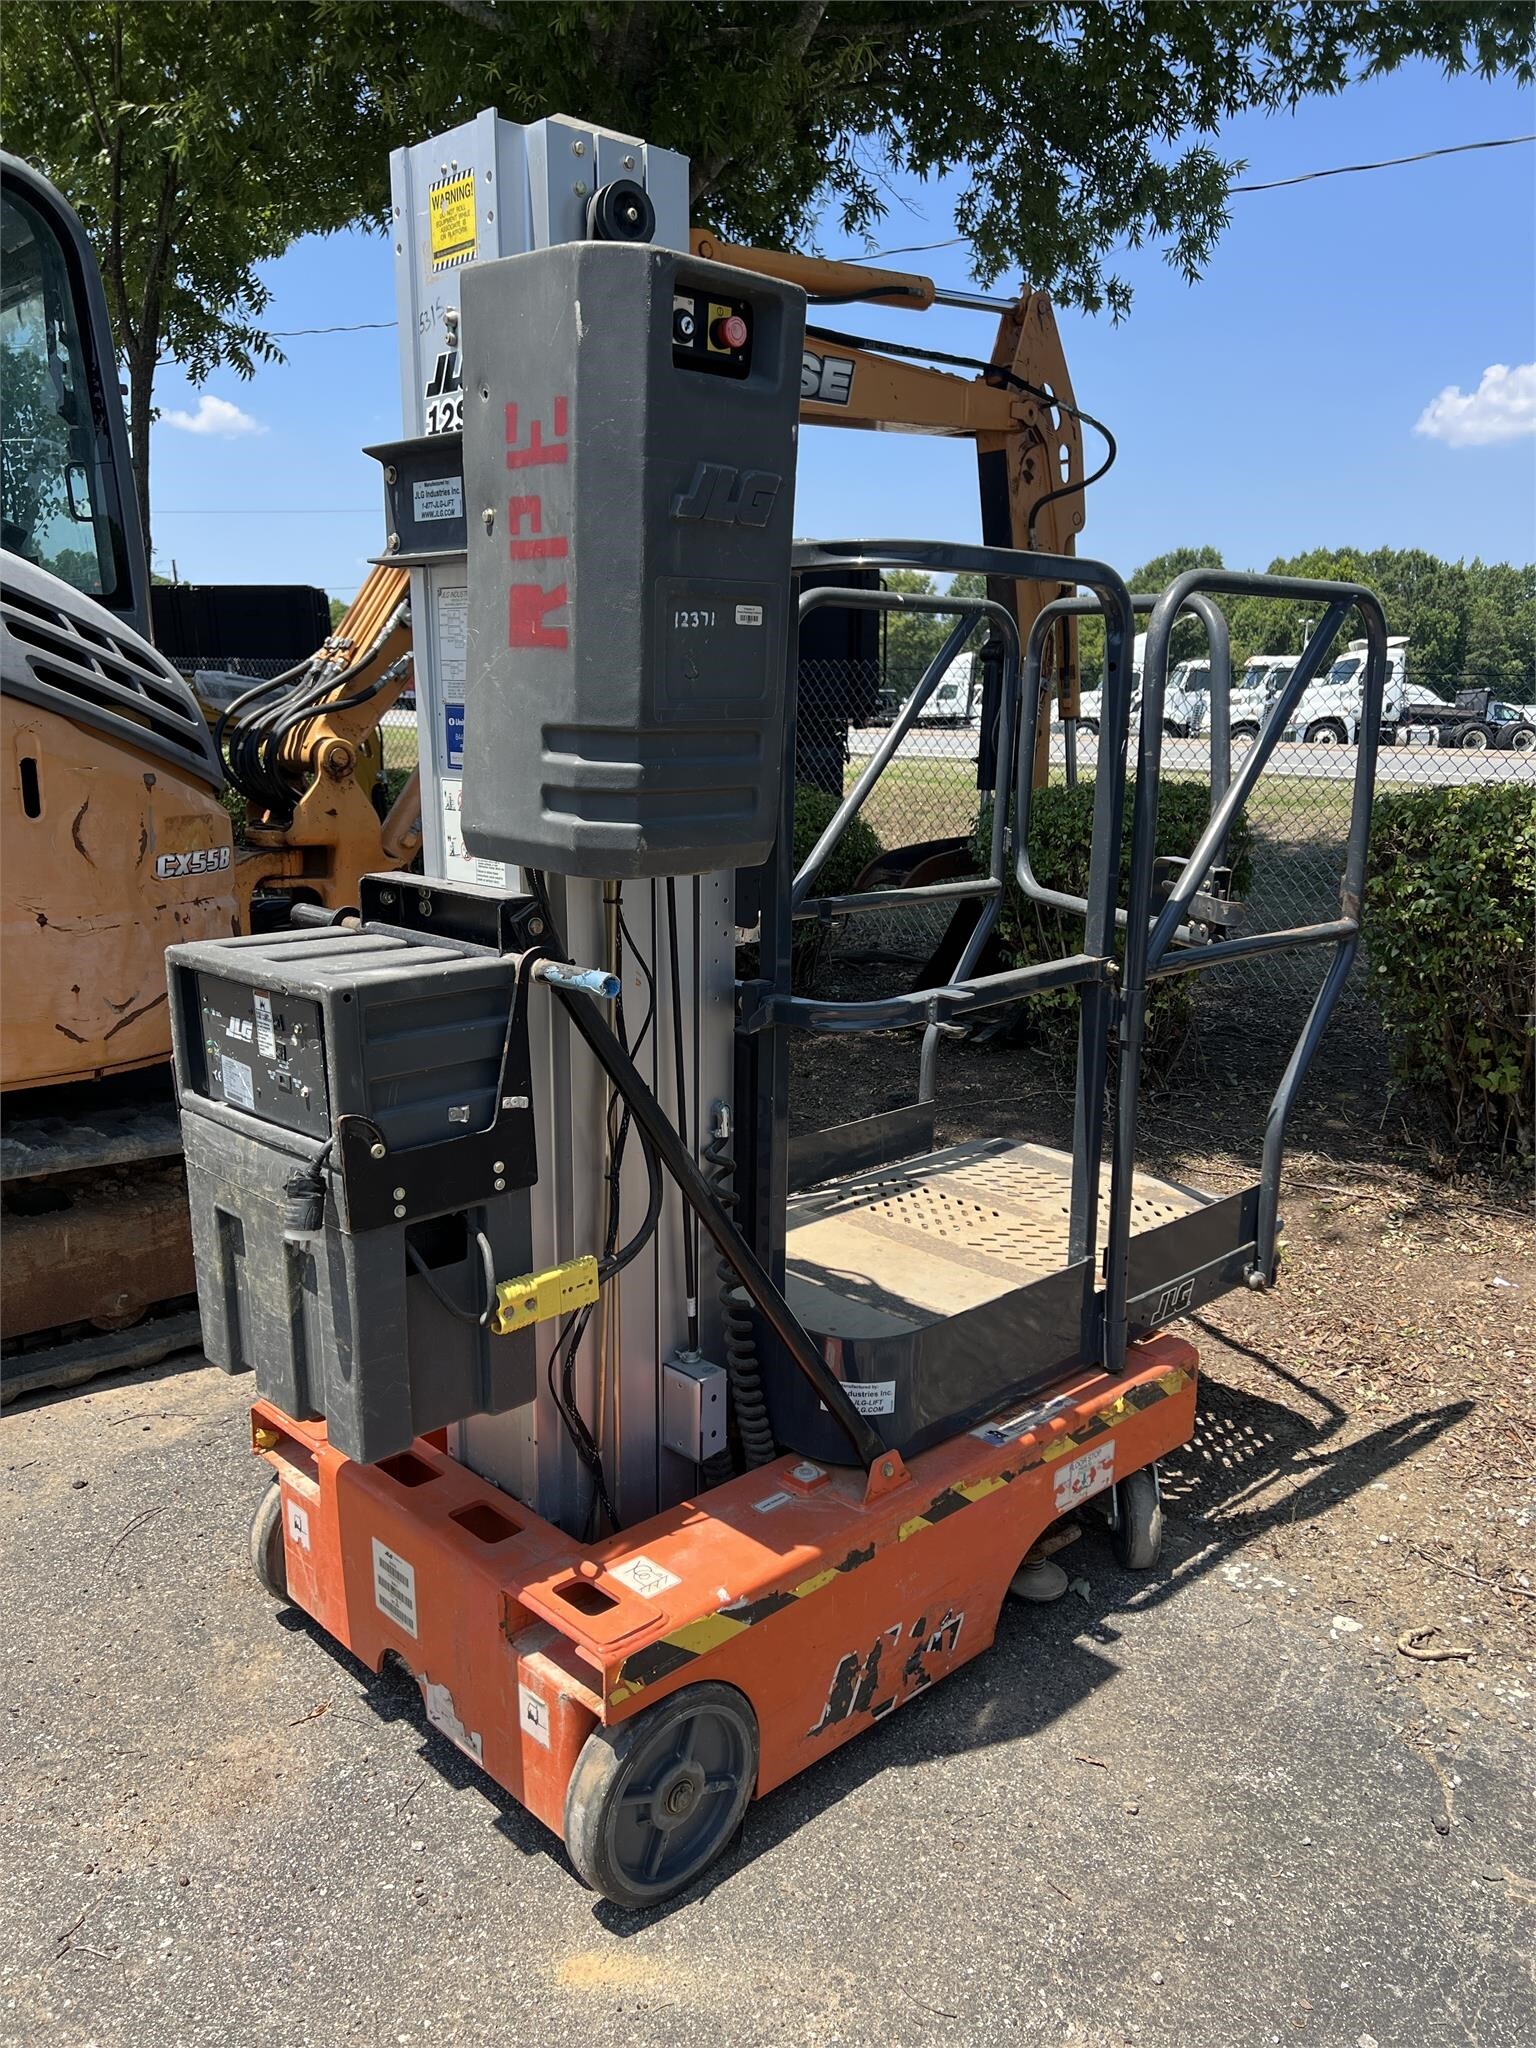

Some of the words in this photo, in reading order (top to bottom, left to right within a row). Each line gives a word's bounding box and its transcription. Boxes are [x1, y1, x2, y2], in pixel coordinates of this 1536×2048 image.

[432, 182, 474, 211] WARNING!
[425, 488, 451, 498] Industries
[673, 462, 782, 528] JLG
[674, 611, 715, 629] 12371
[156, 846, 231, 878] CX55B
[225, 1016, 253, 1043] JLG
[1150, 1277, 1195, 1326] JLG
